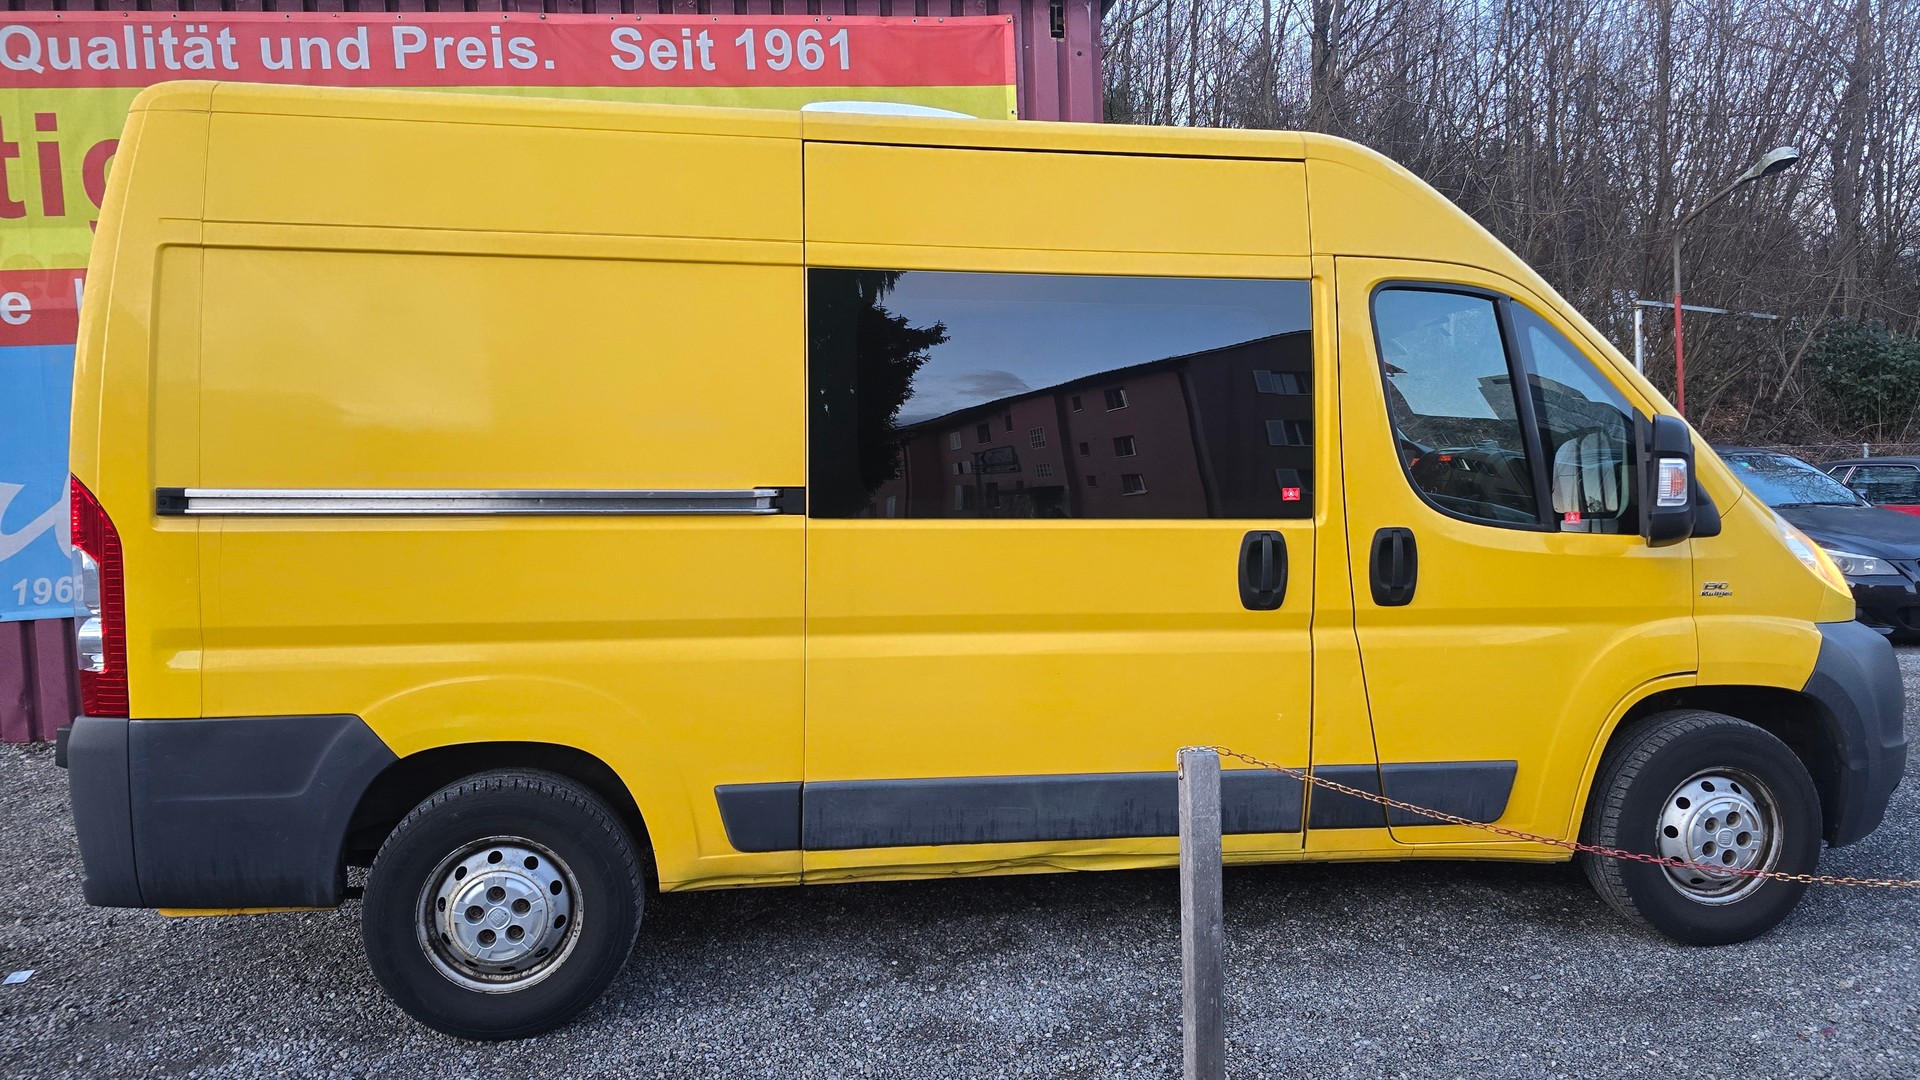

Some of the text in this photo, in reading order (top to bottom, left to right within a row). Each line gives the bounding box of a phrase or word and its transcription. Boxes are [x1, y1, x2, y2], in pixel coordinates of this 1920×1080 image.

[0, 25, 850, 74] Qualität und Preis. Seit 1961
